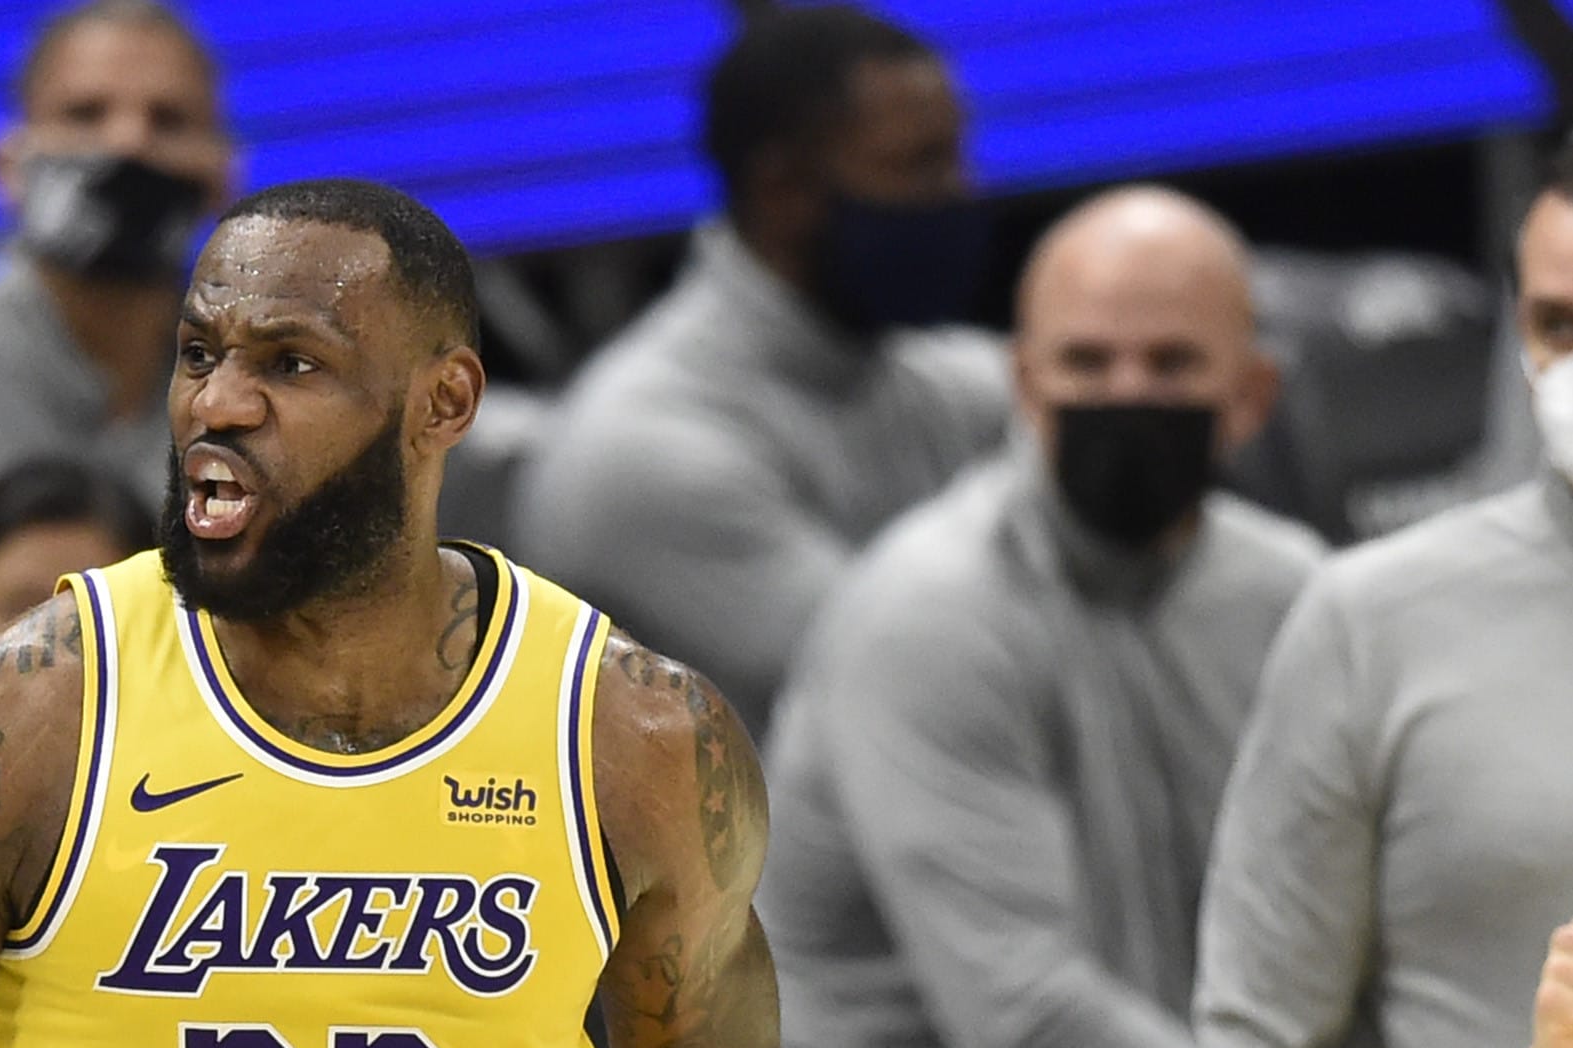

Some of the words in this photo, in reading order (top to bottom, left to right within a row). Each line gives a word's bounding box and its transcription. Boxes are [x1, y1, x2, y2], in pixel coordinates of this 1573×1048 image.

[443, 775, 537, 811] wish
[447, 811, 537, 826] SHOPPING
[93, 842, 540, 998] LAKERS
